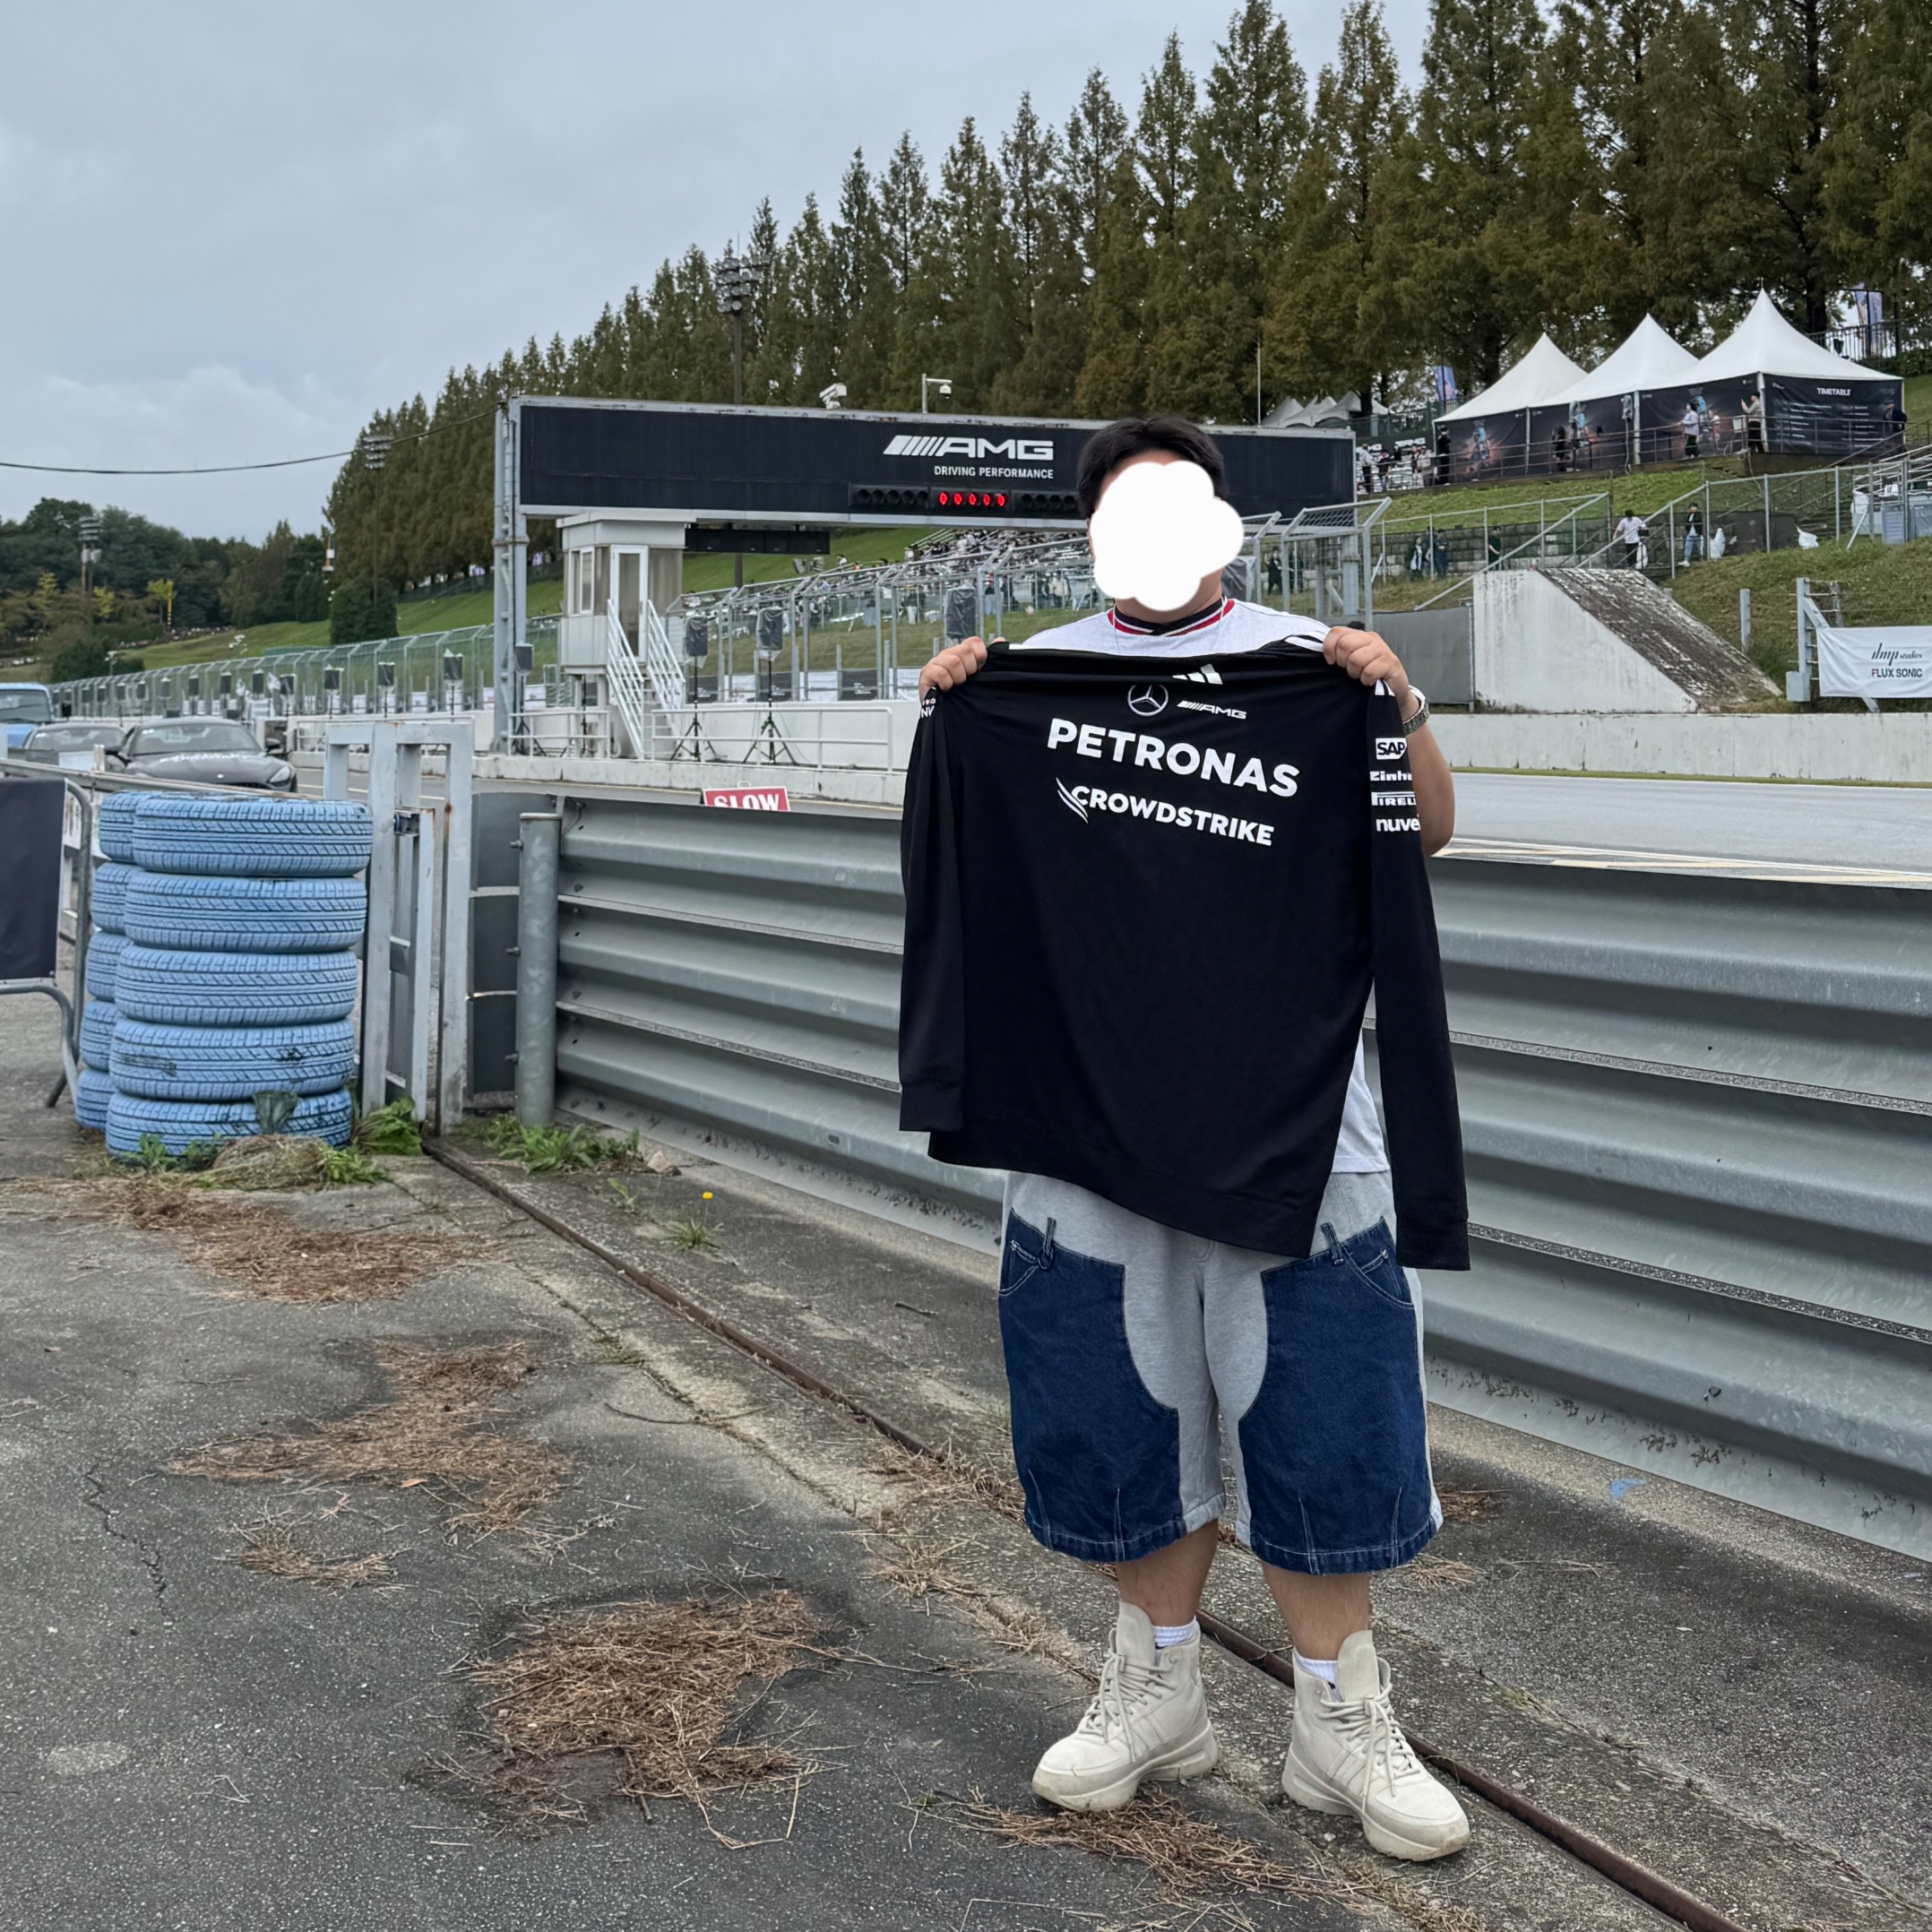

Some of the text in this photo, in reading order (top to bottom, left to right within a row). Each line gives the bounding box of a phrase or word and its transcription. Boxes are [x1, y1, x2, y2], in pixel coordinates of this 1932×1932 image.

[934, 436, 1054, 461] AMG
[934, 465, 1054, 479] DRIVING PERFORMANCE
[1871, 668, 1923, 678] FLUX SONIC
[1200, 703, 1247, 720] AMG
[1376, 742, 1405, 755] SAP
[1047, 718, 1300, 798] PETRONAS
[1371, 791, 1417, 806] PIREL
[1071, 785, 1274, 846] CROWDSTRIKE
